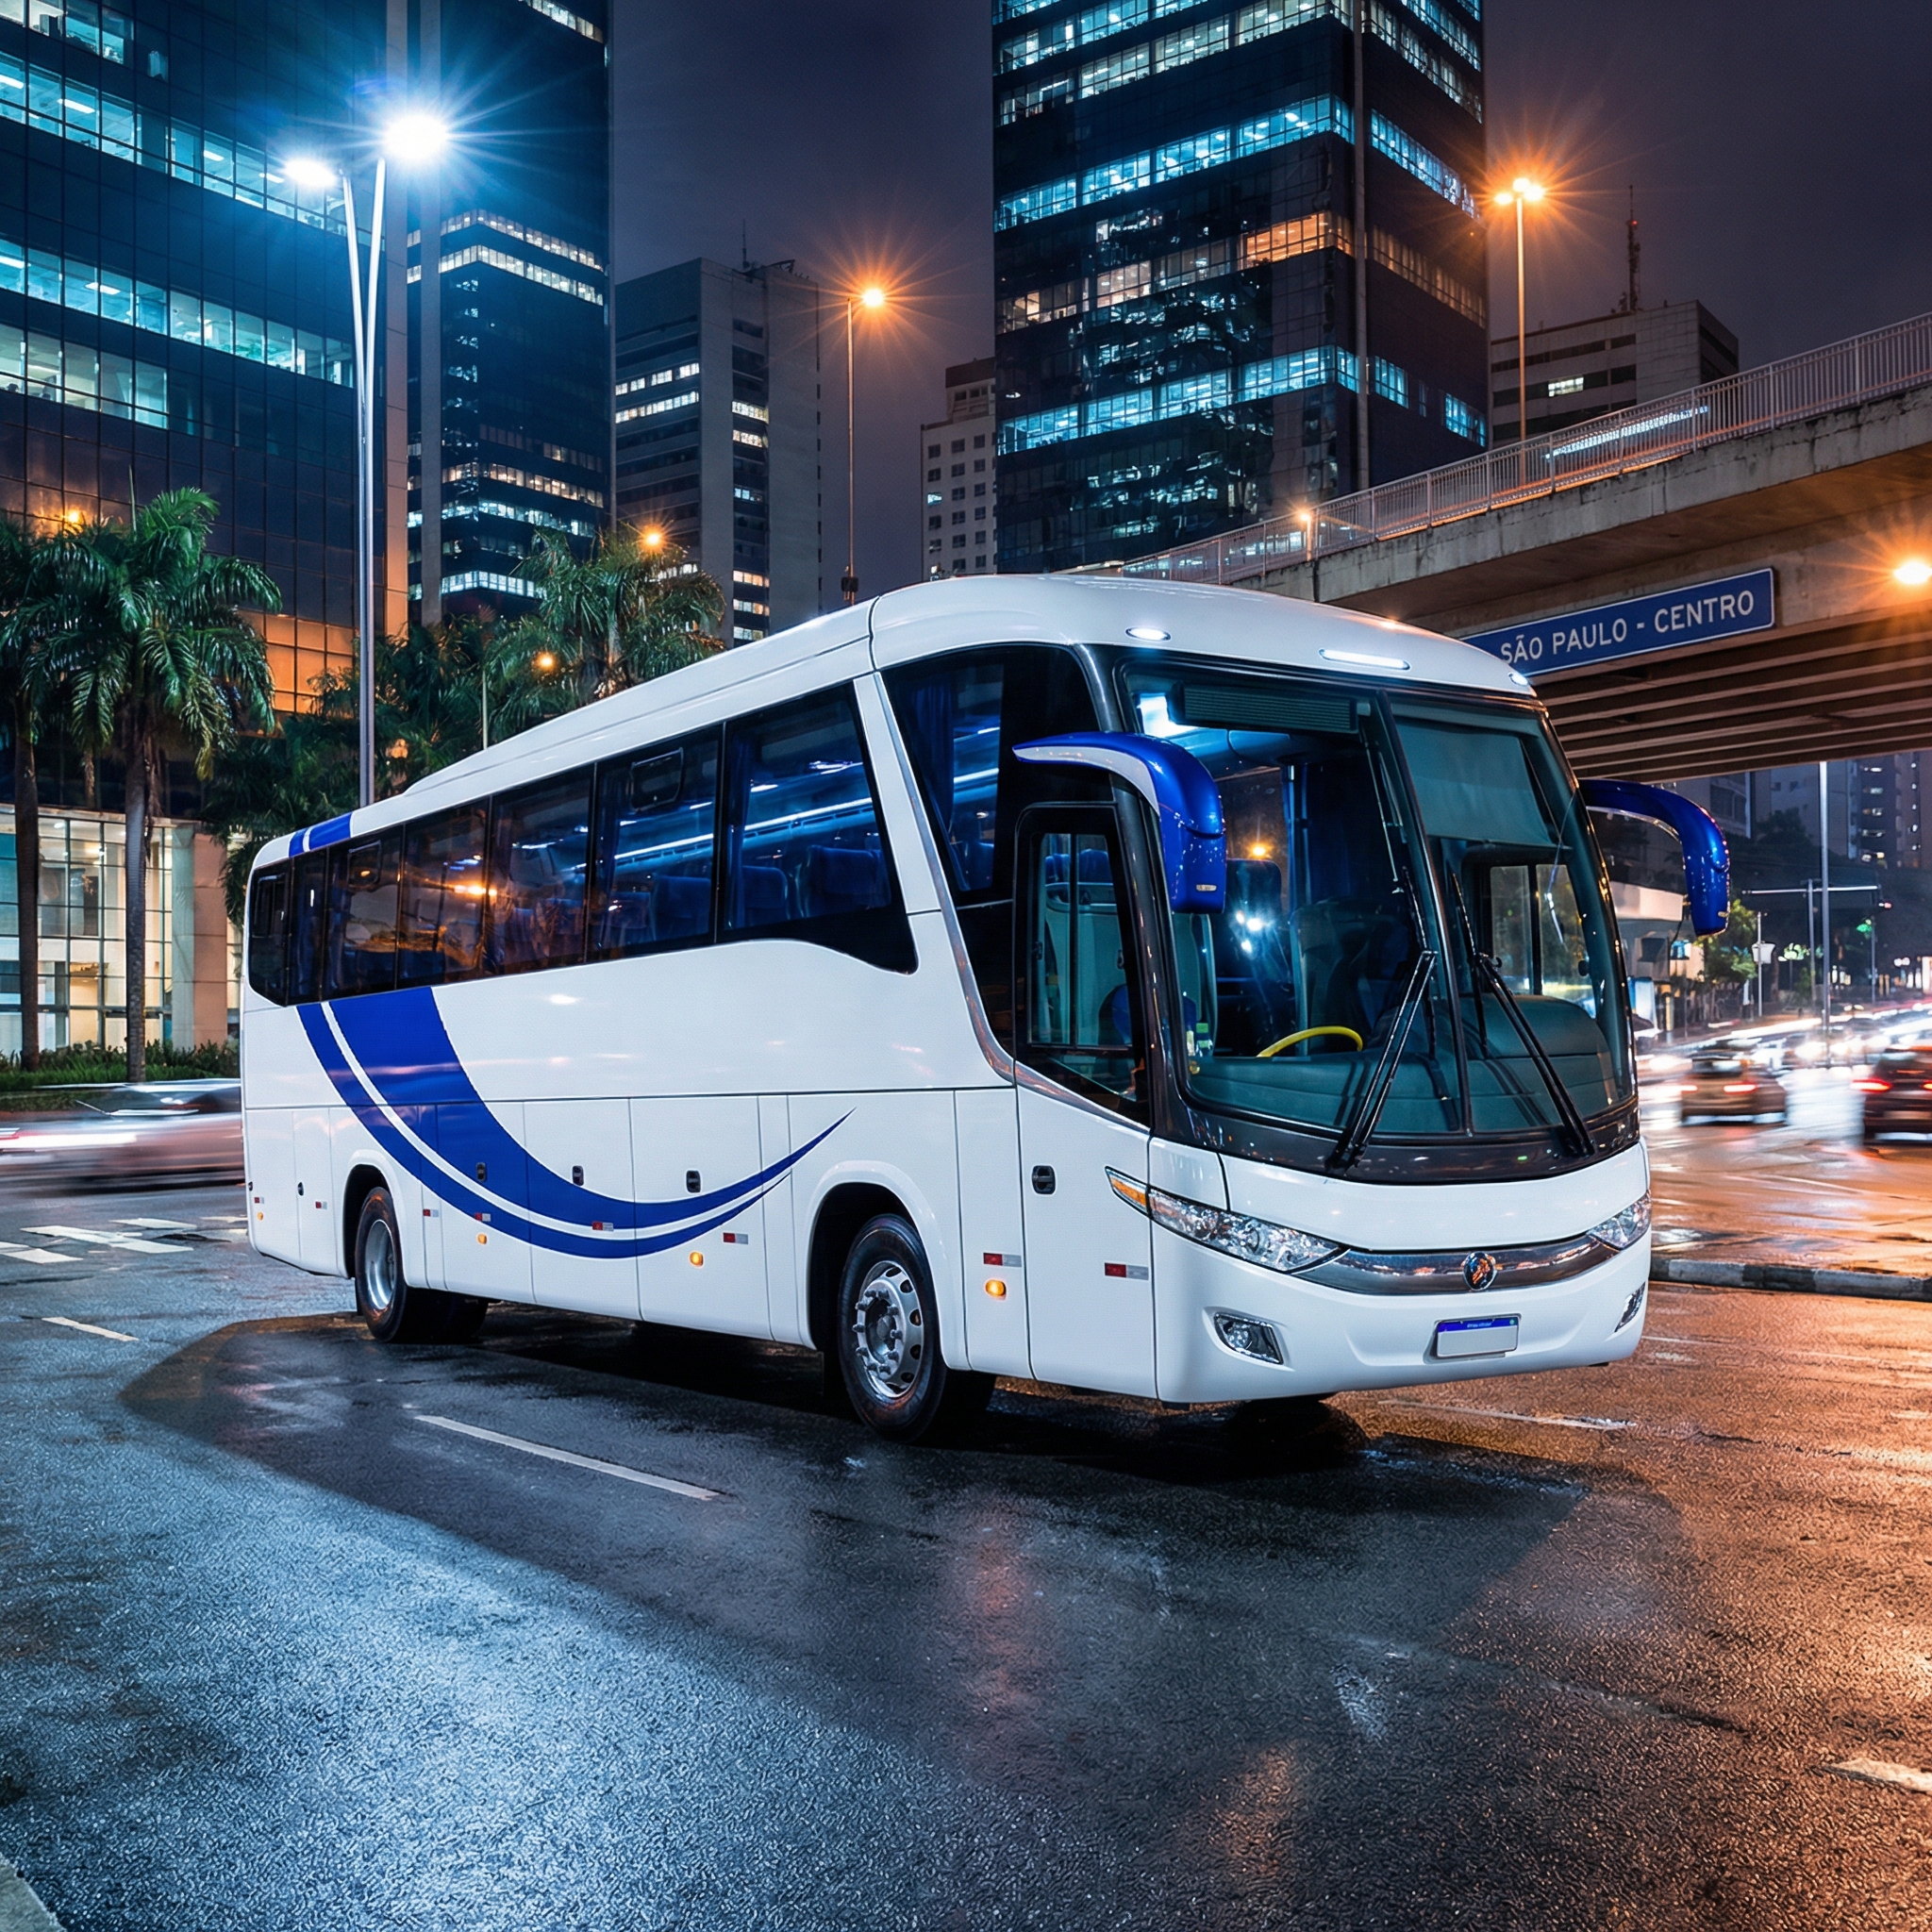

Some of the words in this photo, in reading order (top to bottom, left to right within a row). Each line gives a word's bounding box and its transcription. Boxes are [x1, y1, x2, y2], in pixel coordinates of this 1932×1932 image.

[1500, 634, 1542, 663] SÃO
[1552, 618, 1627, 655] PAULO
[1654, 590, 1754, 633] CENTRO
